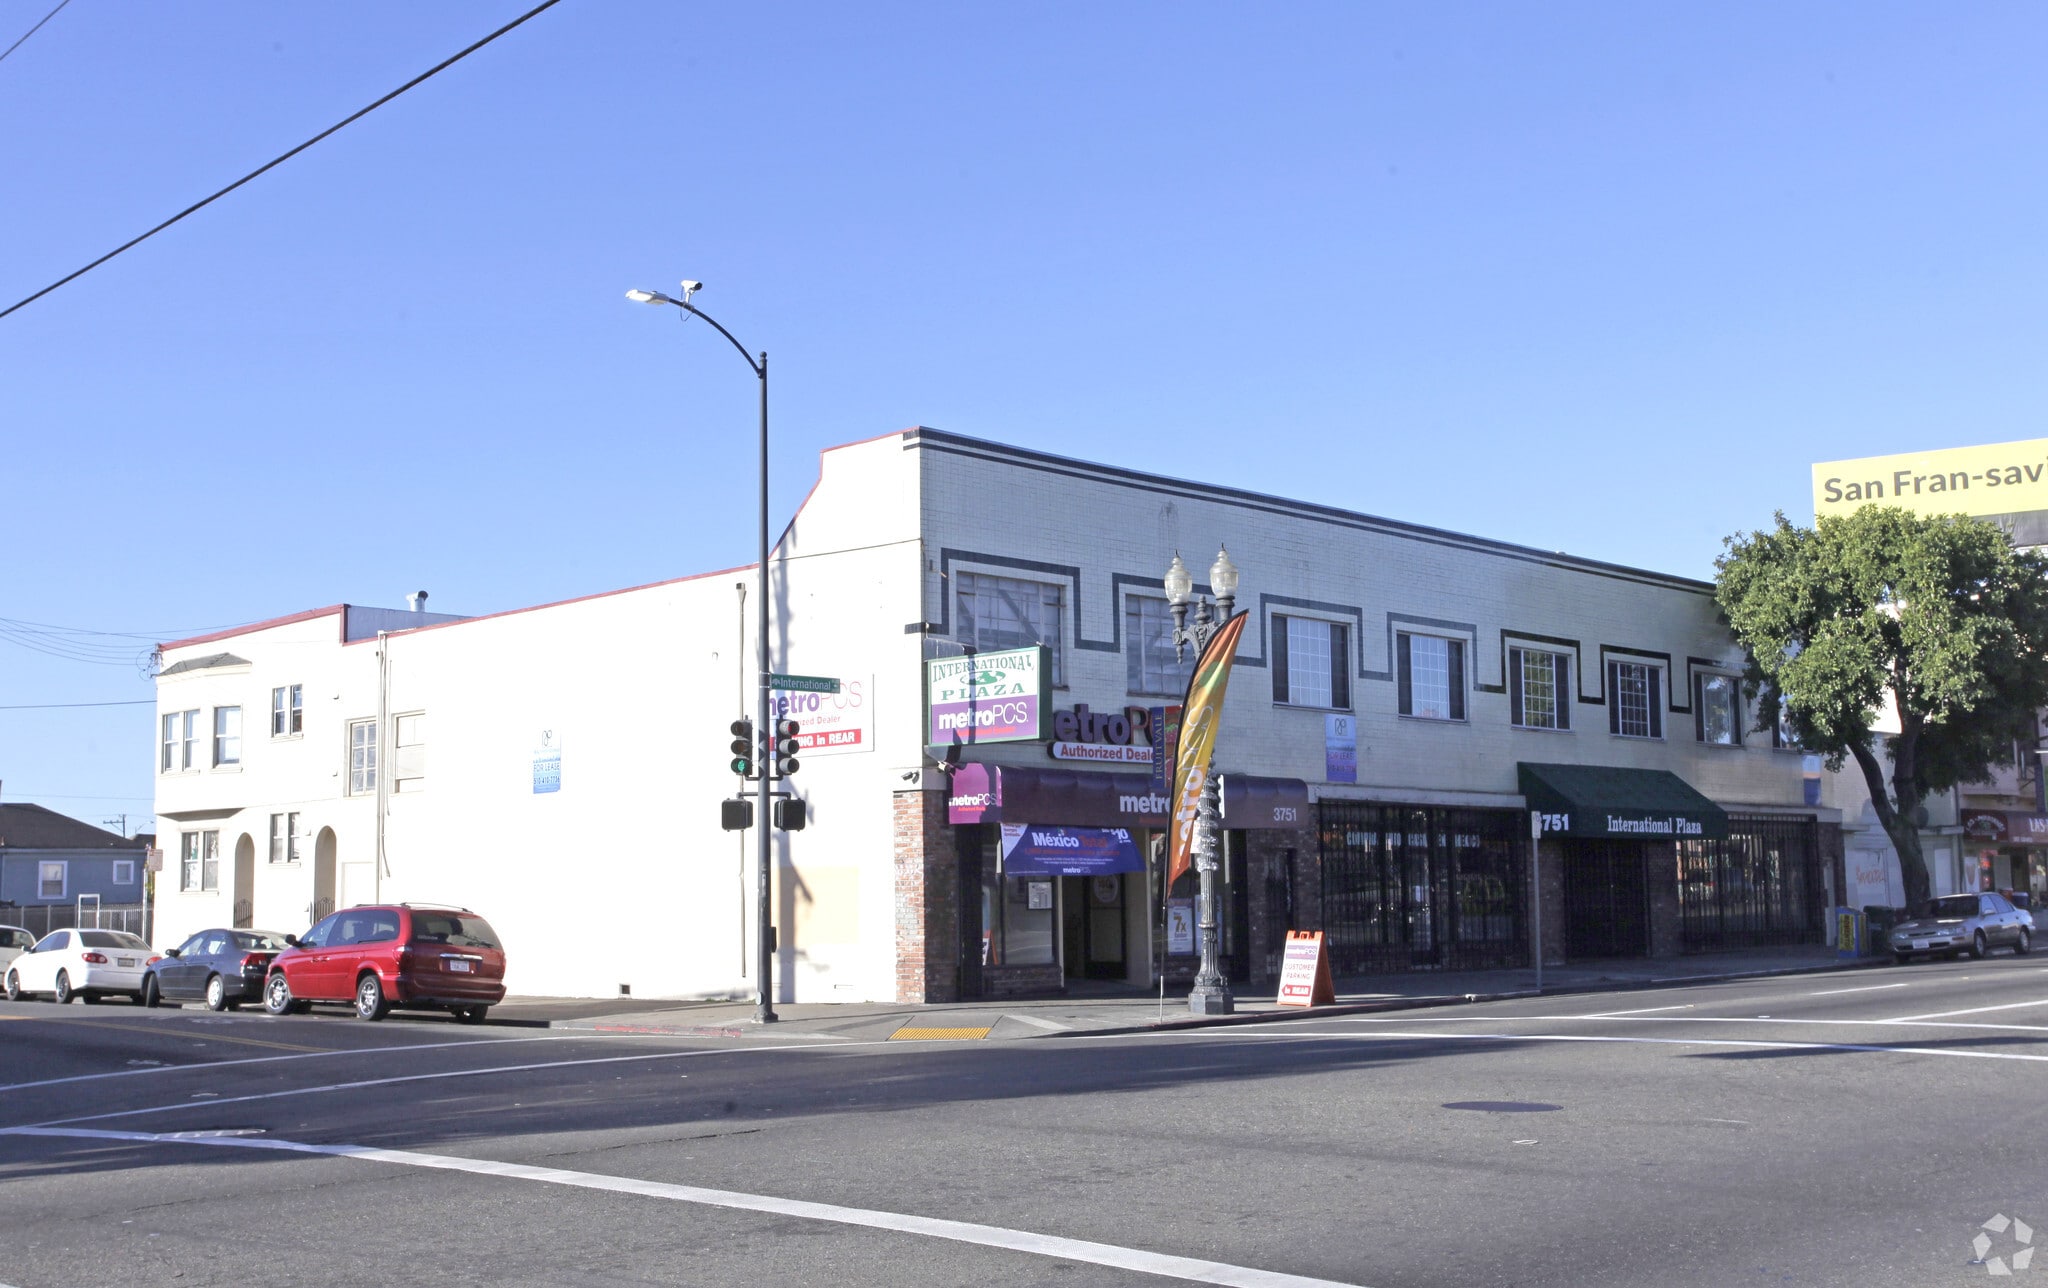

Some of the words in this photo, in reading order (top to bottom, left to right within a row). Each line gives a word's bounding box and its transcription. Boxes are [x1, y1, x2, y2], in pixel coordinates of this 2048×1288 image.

[1824, 478, 1884, 503] San
[932, 654, 1036, 682] INTERNATIONAL
[781, 677, 831, 690] International
[940, 682, 1025, 700] PLAZA
[816, 733, 826, 746] in
[828, 731, 855, 744] REAR
[1155, 713, 1164, 780] FRUITVALE
[1060, 744, 1123, 760] Authorized
[1273, 807, 1298, 822] 3751
[1607, 814, 1672, 833] International
[1675, 817, 1702, 834] Plaza
[1031, 832, 1079, 848] México
[1111, 827, 1128, 841] $10
[1284, 963, 1315, 971] CUSTOMER
[1286, 972, 1310, 980] PARKING
